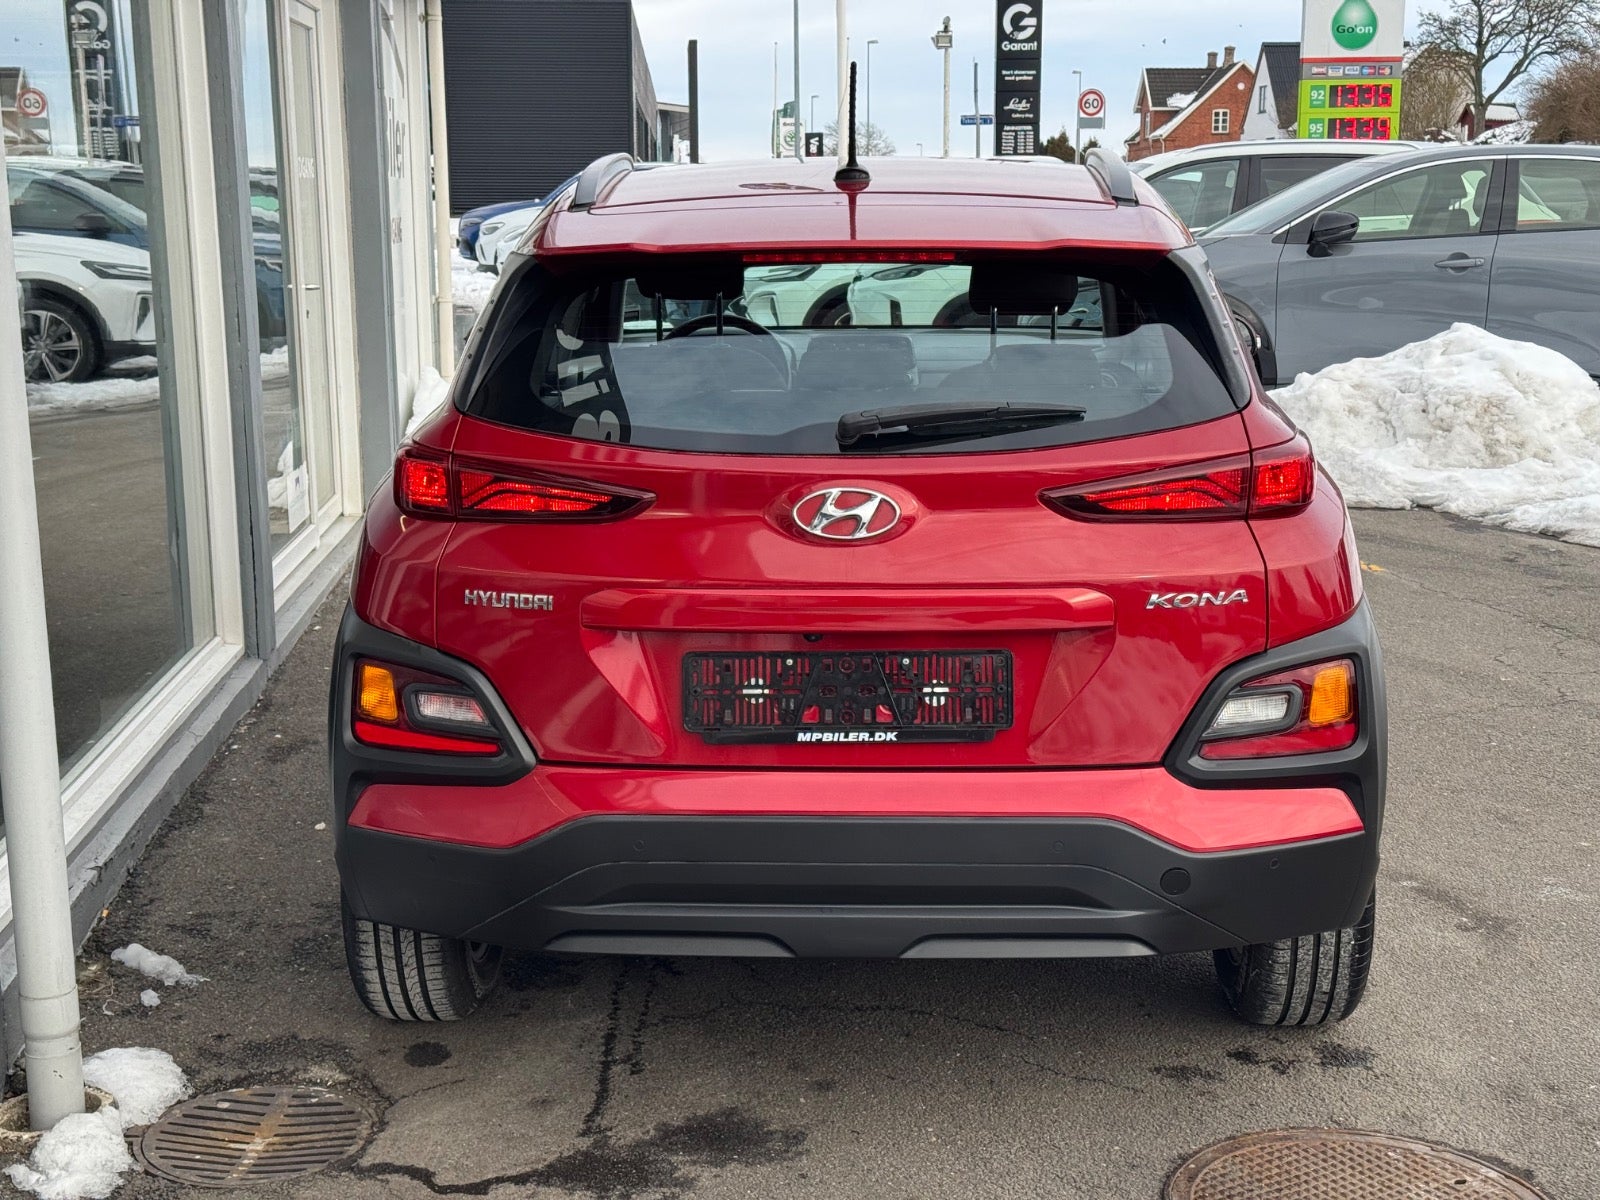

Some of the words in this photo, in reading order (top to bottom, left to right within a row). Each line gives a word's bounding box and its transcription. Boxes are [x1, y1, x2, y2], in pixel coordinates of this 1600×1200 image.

[1001, 40, 1037, 51] Garant
[1311, 90, 1325, 100] 92
[1083, 98, 1100, 109] 60
[1309, 123, 1324, 133] 95
[464, 589, 554, 611] HYUNDAI
[1145, 589, 1249, 610] KONA
[797, 731, 898, 742] MPBILER.DK
